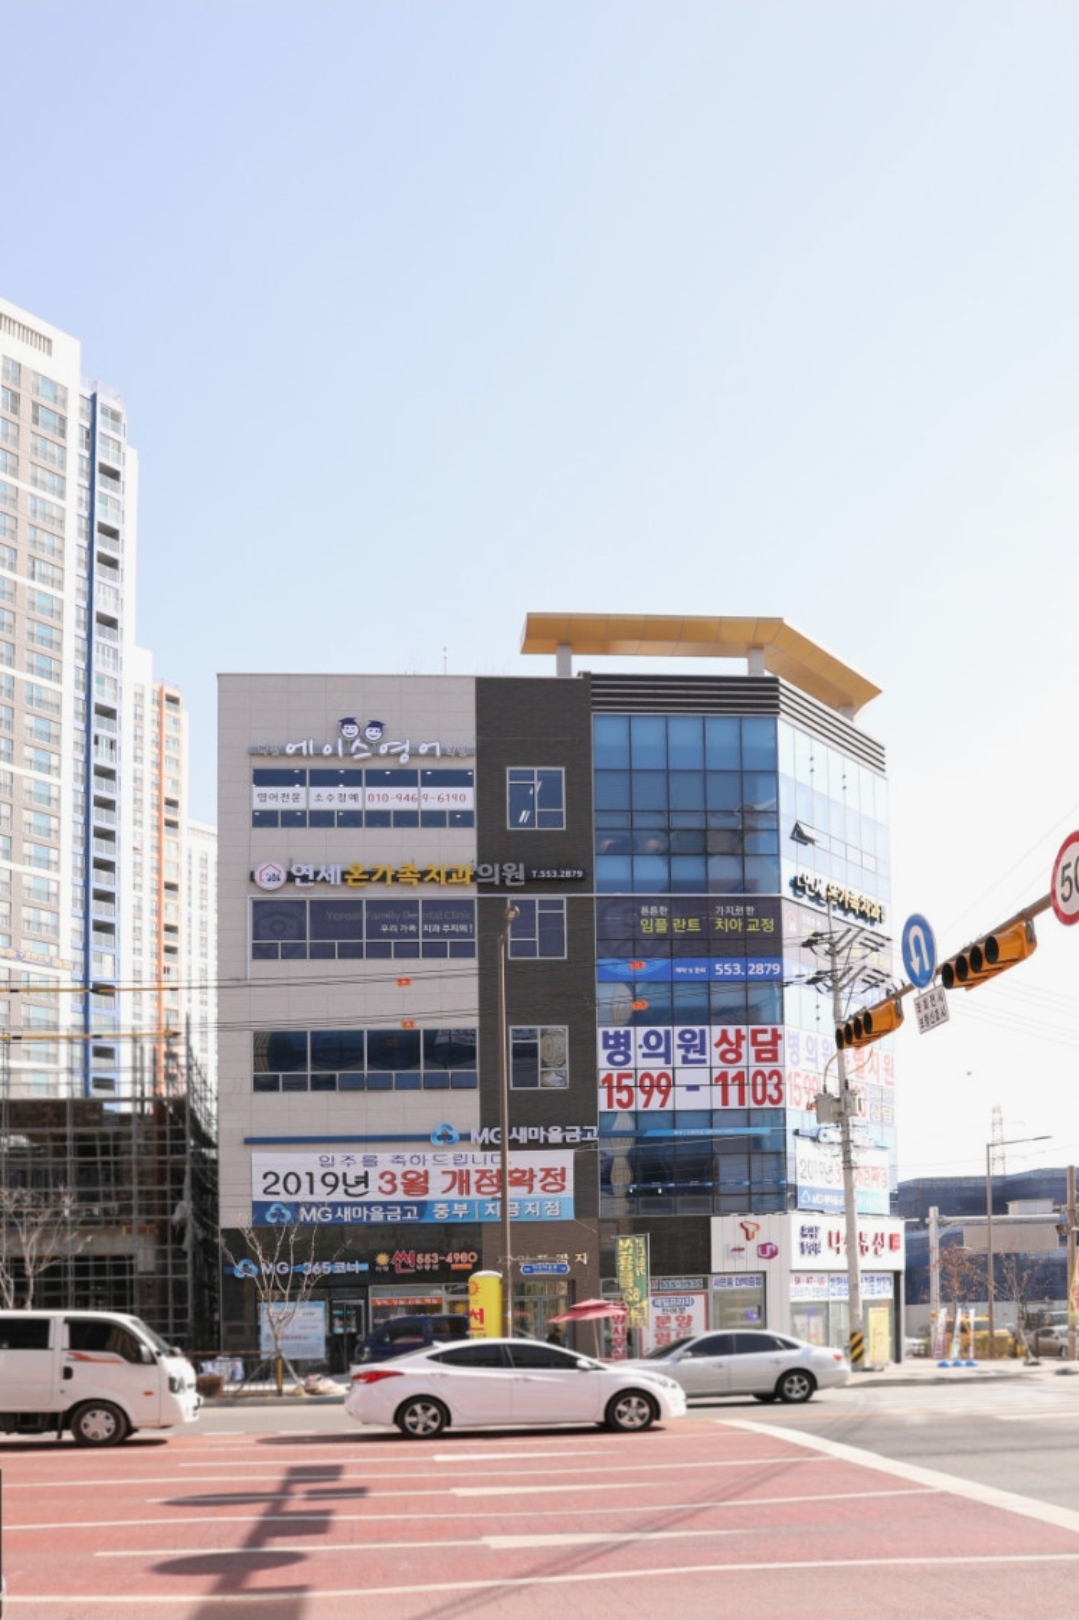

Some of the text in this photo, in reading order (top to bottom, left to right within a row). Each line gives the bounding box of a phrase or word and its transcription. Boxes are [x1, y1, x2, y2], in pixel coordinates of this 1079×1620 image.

[284, 738, 441, 764] 에이스영어
[367, 792, 467, 803] 010-9469-6190
[714, 1028, 783, 1065] 상담
[319, 1154, 379, 1168] 입주를
[262, 1170, 370, 1197] 2019년
[378, 1169, 430, 1197] 3월
[433, 1203, 470, 1220] 중부
